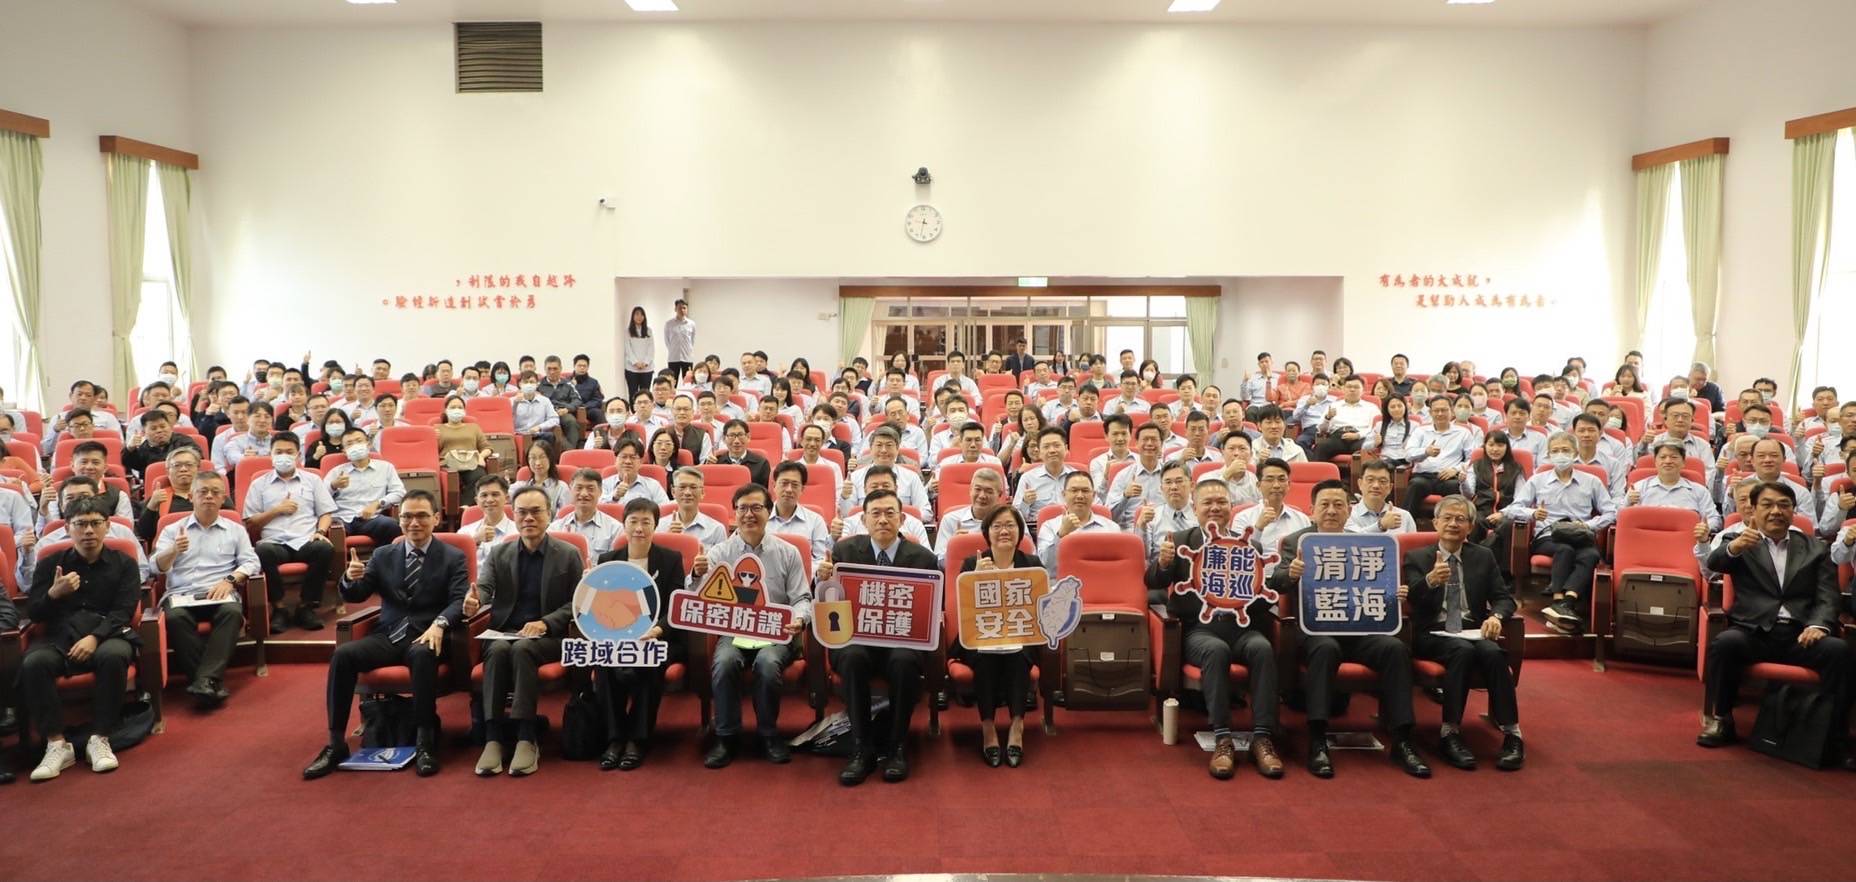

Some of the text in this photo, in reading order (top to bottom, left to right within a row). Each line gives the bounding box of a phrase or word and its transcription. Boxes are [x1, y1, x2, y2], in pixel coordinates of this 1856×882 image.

[1202, 546, 1255, 572] 廉能
[1313, 545, 1385, 581] 清淨
[858, 580, 915, 609] 機密
[974, 579, 1033, 609] 國家
[1200, 572, 1254, 600] 海巡
[680, 597, 784, 637] 保密防諜
[1314, 586, 1387, 622] 藍海
[857, 608, 913, 637] 保護
[975, 610, 1034, 640] 安全
[563, 641, 666, 665] 跨域合作
